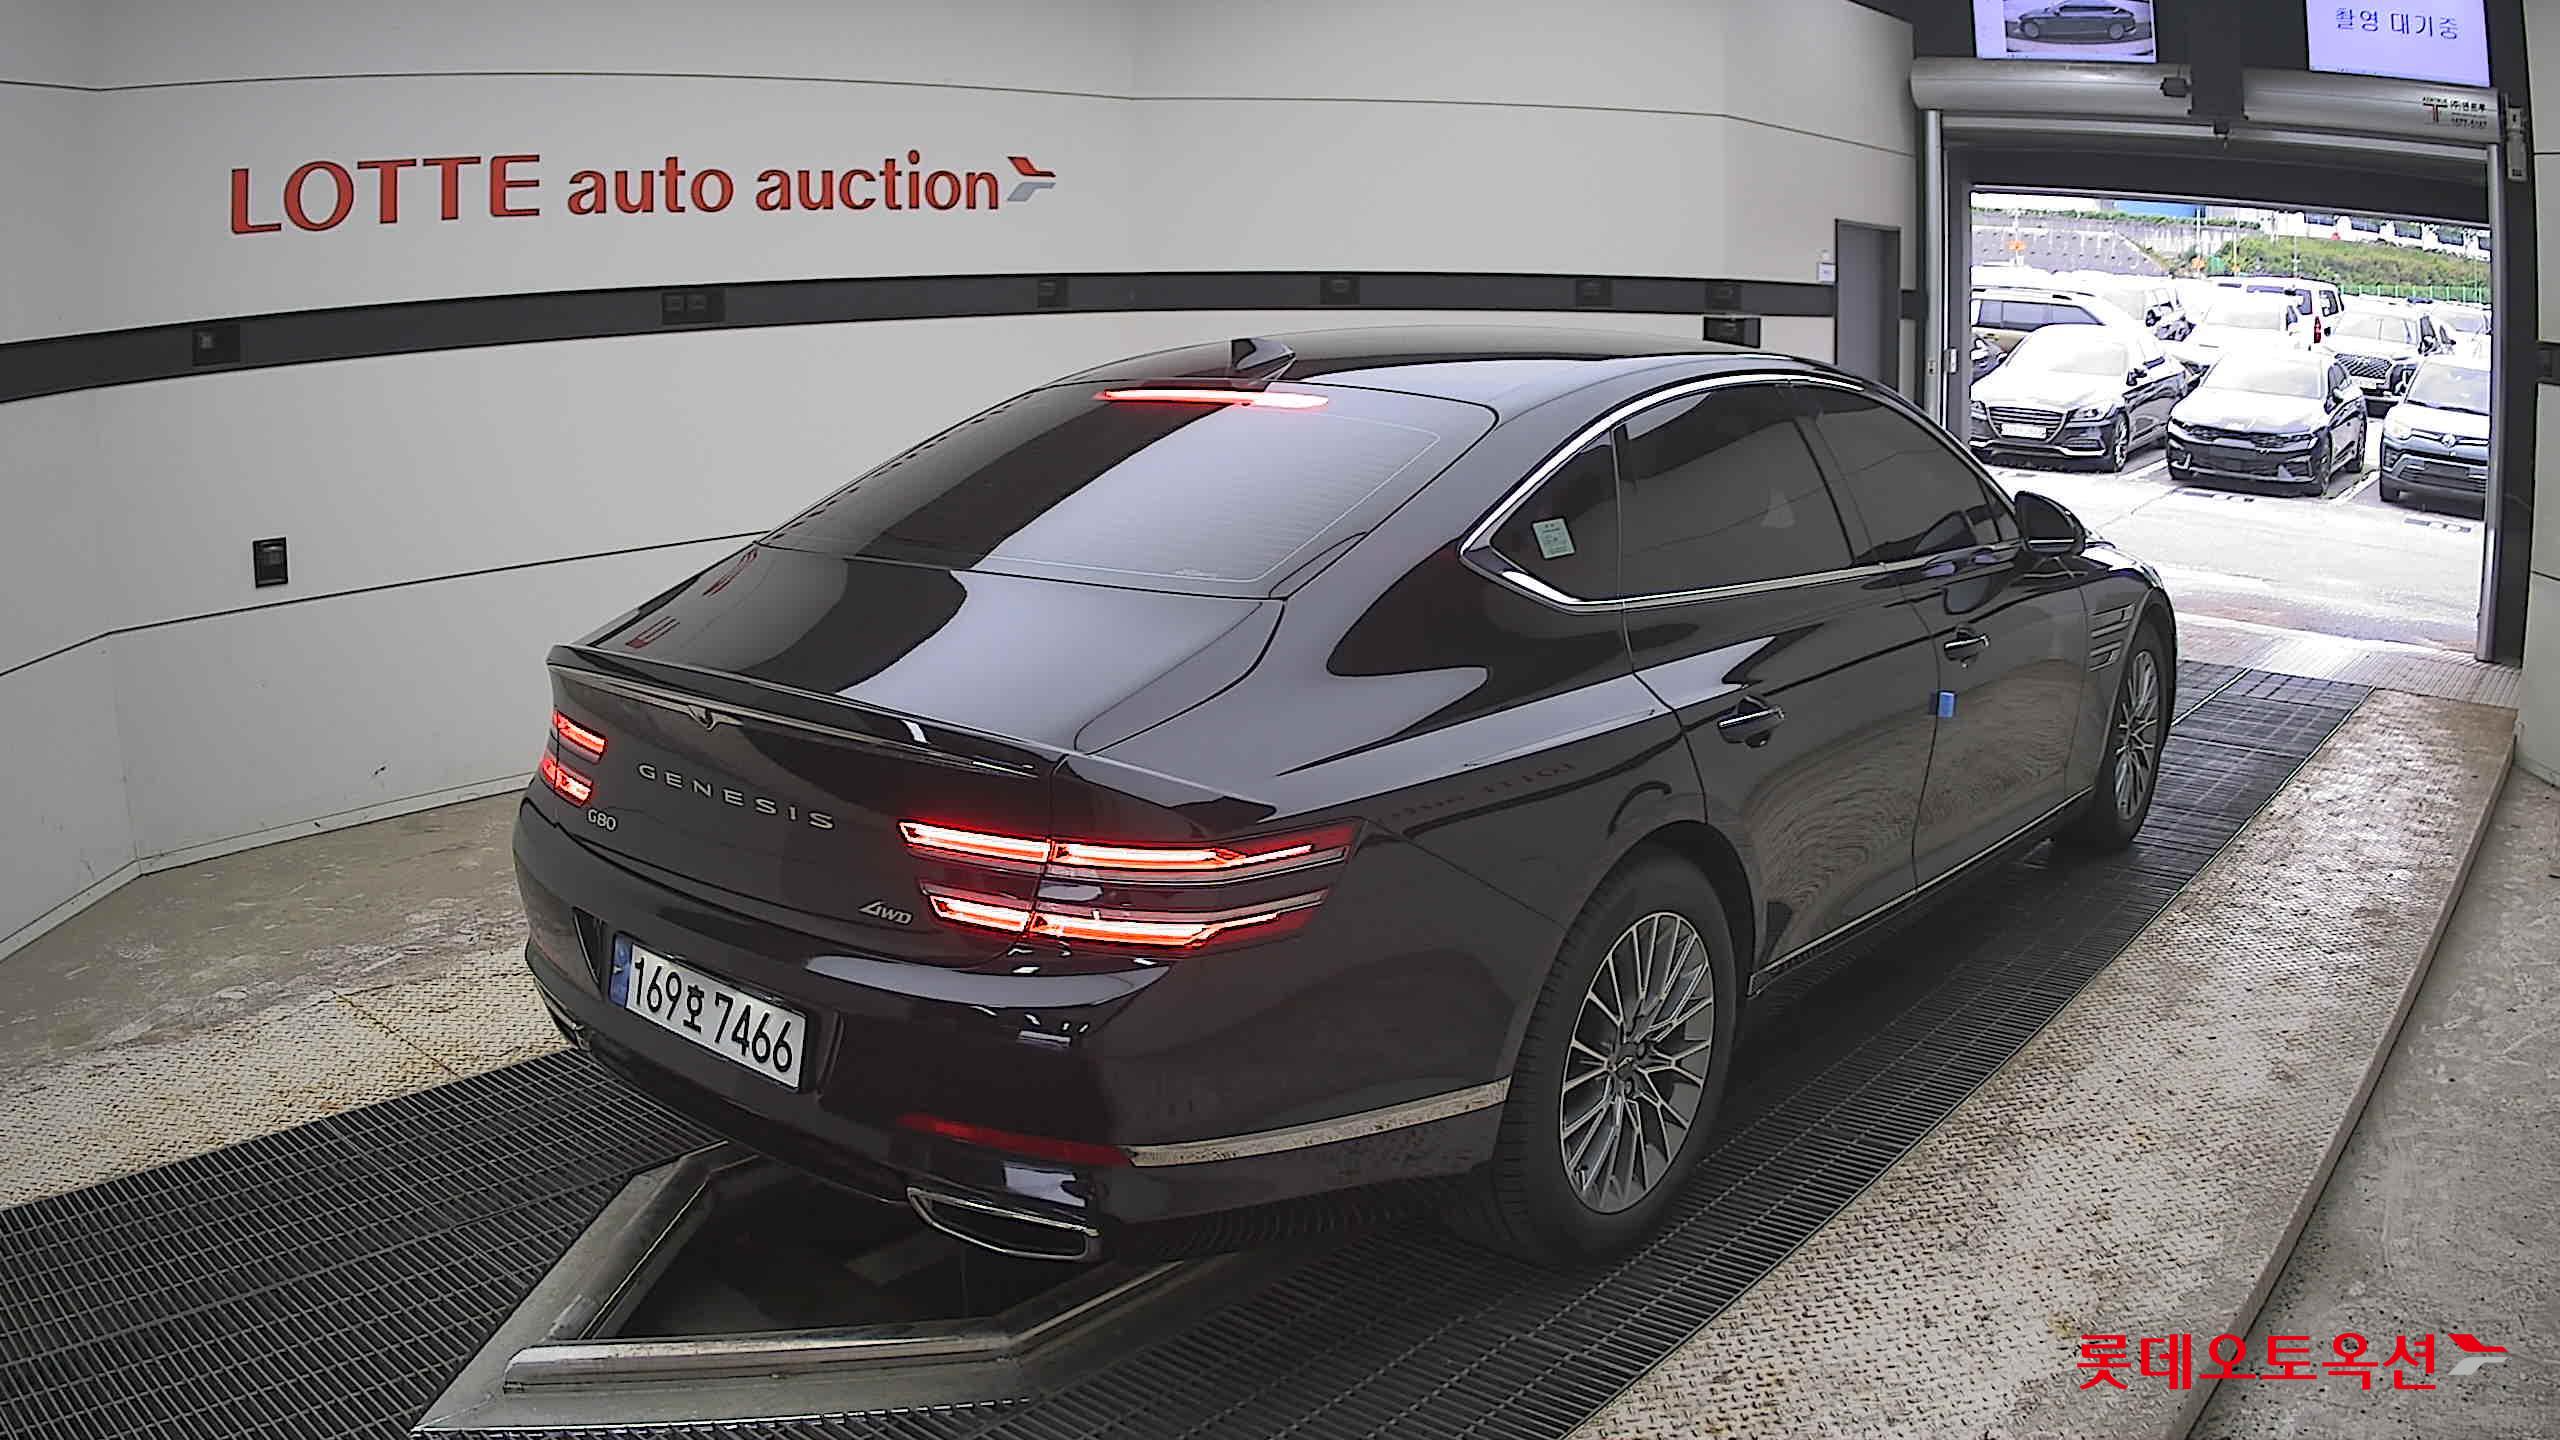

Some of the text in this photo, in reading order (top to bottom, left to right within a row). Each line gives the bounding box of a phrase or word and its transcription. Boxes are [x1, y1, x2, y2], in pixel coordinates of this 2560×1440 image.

[2335, 8, 2379, 32] 촬영
[231, 150, 1000, 234] LOTTE auto auction
[587, 808, 617, 831] G80
[637, 764, 834, 830] GENESIS
[634, 957, 793, 1073] 169호 7466
